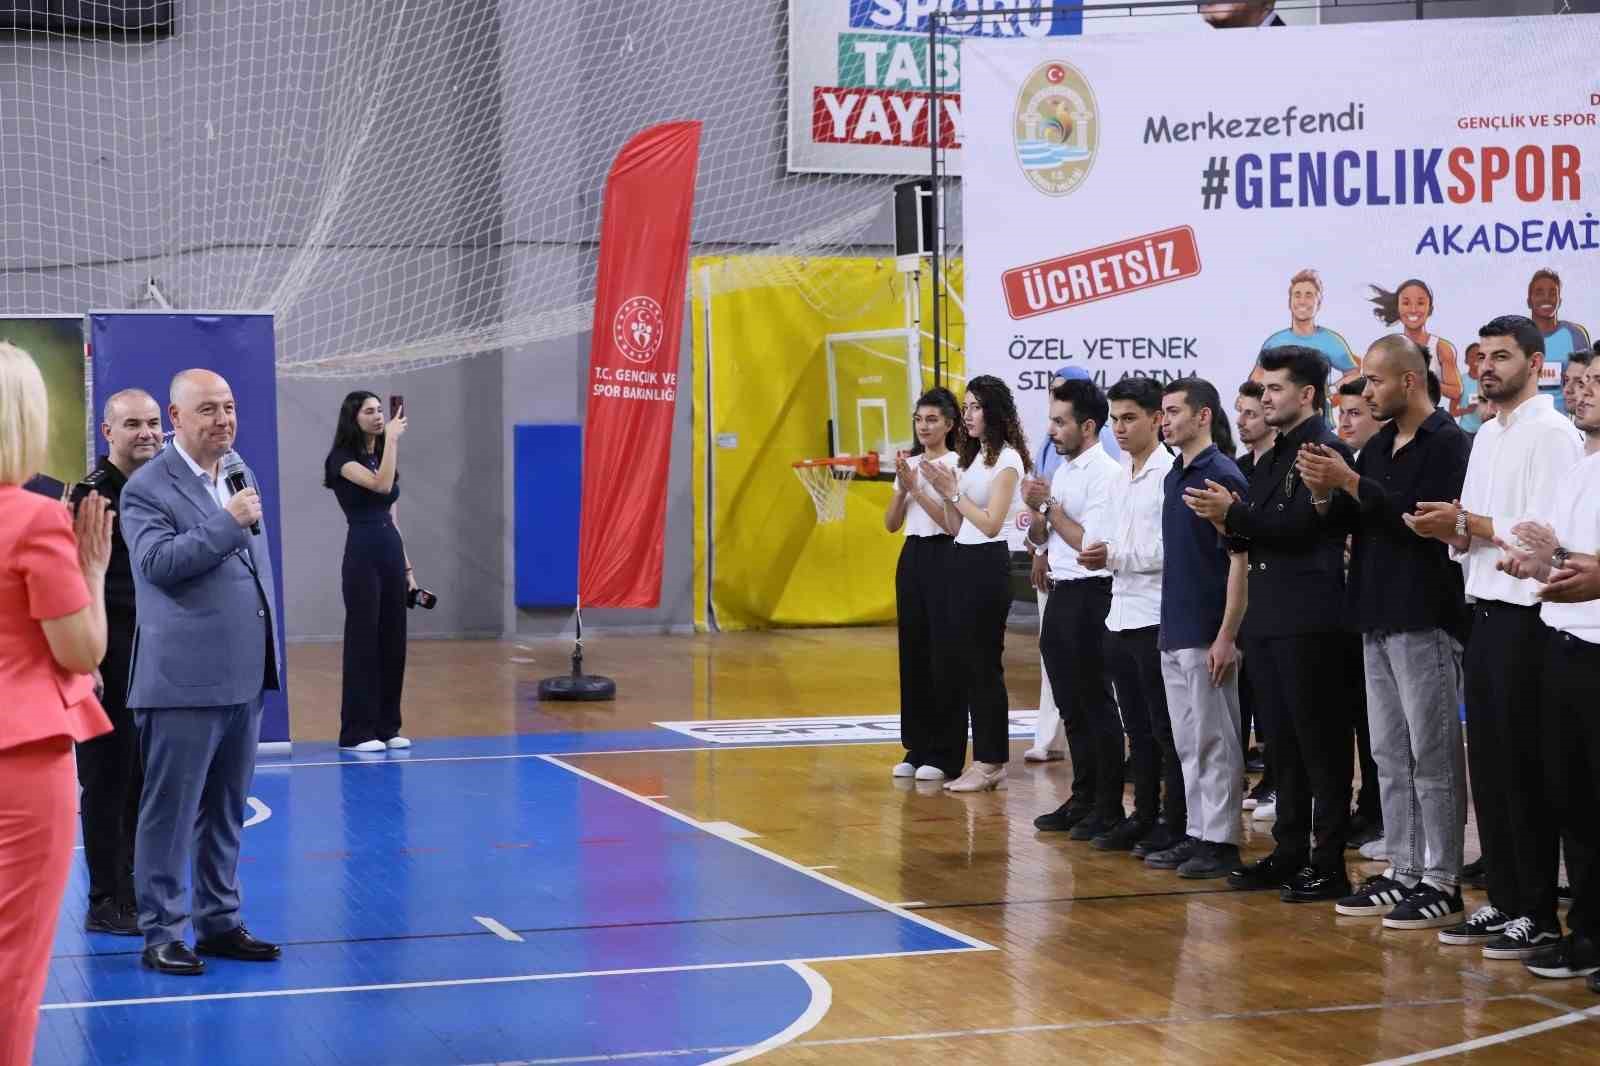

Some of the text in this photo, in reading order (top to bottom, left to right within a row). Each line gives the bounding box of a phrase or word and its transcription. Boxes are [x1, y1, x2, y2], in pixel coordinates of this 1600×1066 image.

[854, 41, 961, 88] TAB
[1143, 103, 1365, 144] Merkezefendi
[1457, 113, 1596, 131] GENÇLİK VE SPOR
[1201, 144, 1581, 210] #GENCLIKSPOR
[1022, 239, 1180, 311] ÜCRETSİZ
[1008, 335, 1198, 360] ÖZEL YETENEK
[593, 384, 621, 397] SPOR
[594, 367, 613, 381] T.C.
[662, 373, 678, 385] VE
